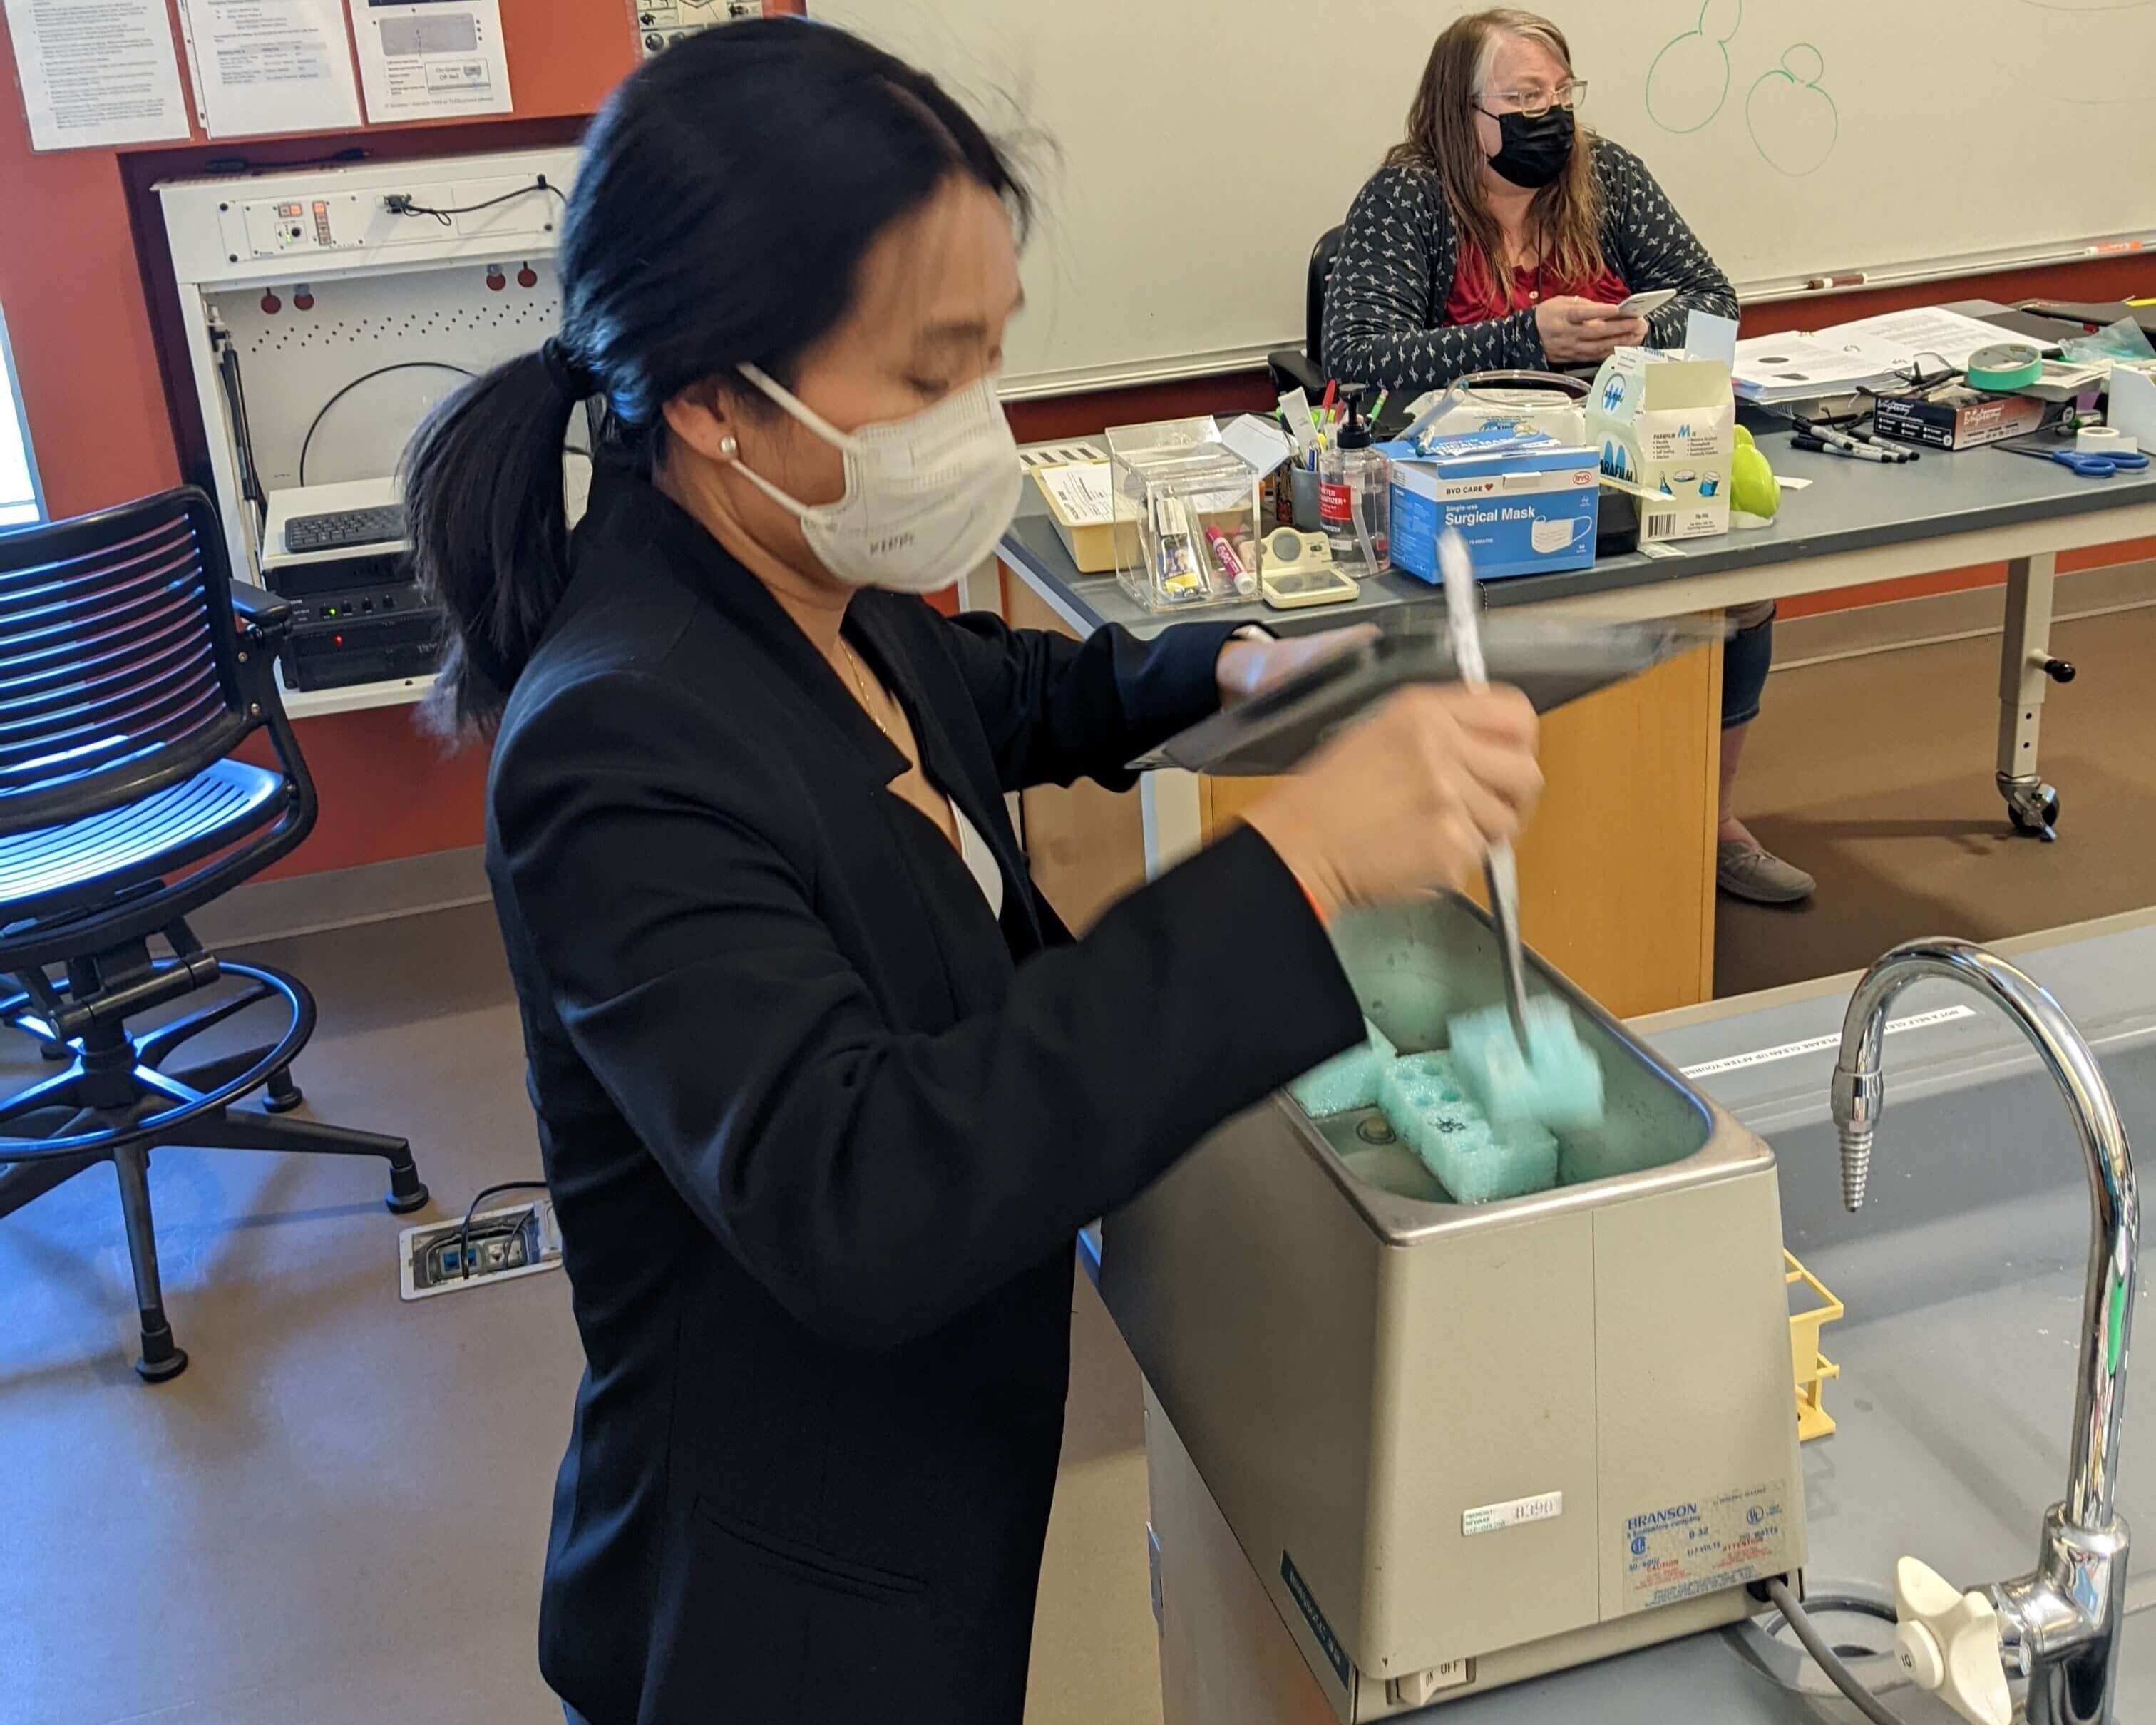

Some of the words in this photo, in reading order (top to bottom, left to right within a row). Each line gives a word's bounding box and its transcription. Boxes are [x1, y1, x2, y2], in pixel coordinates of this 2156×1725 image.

[1599, 459, 1633, 483] ARAFILM
[1463, 485, 1483, 493] CARE
[1445, 508, 1497, 526] Surgical
[1502, 506, 1535, 521] Mask
[1802, 1037, 1837, 1048] PLEASE
[1769, 1045, 1800, 1057] CLEAN
[1723, 1056, 1753, 1068] AFTER
[1628, 1503, 1697, 1530] BRANSON
